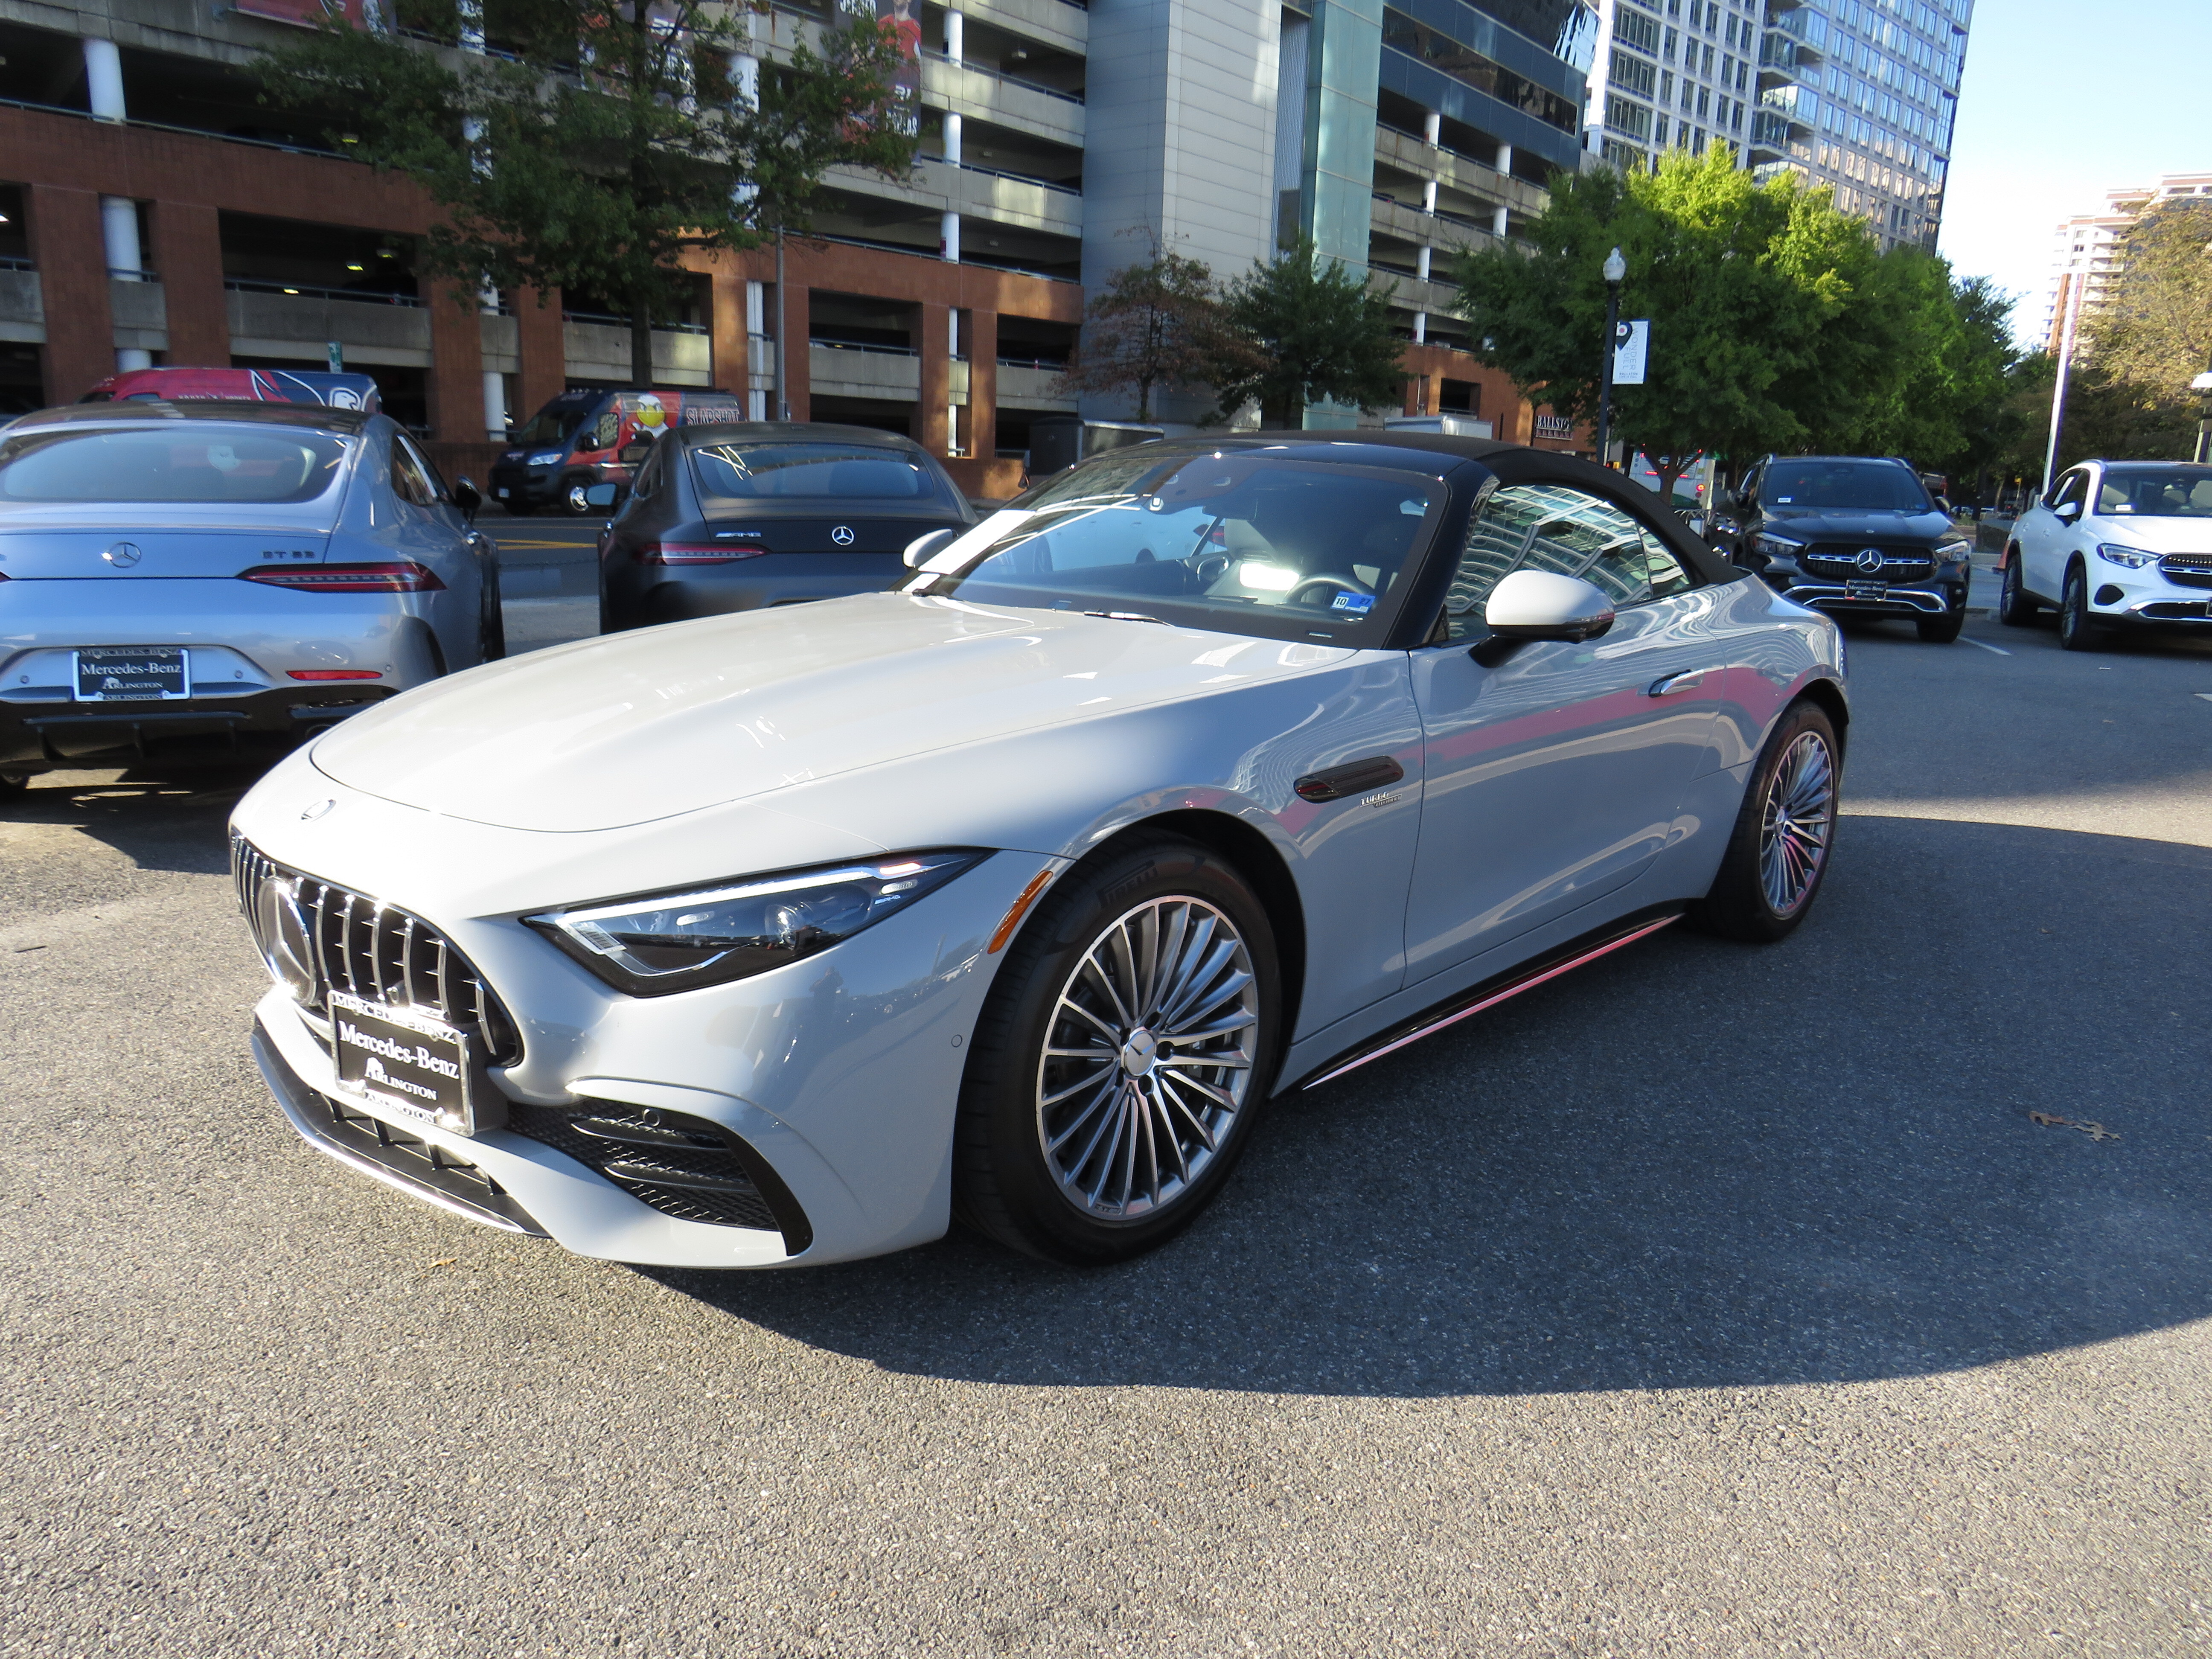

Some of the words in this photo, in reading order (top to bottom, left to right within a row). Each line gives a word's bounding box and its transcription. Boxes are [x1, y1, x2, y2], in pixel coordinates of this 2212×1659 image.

[1629, 327, 1639, 370] WONDER
[686, 407, 740, 425] SLAPSHOT
[1537, 416, 1572, 430] BALLSTO
[81, 662, 181, 675] Mercedes-Benz
[102, 677, 163, 689] ARLINGTON
[1360, 791, 1389, 805] TURBO
[338, 1020, 460, 1079] Mercedes-Benz
[364, 1057, 437, 1100] ARLINGTON
